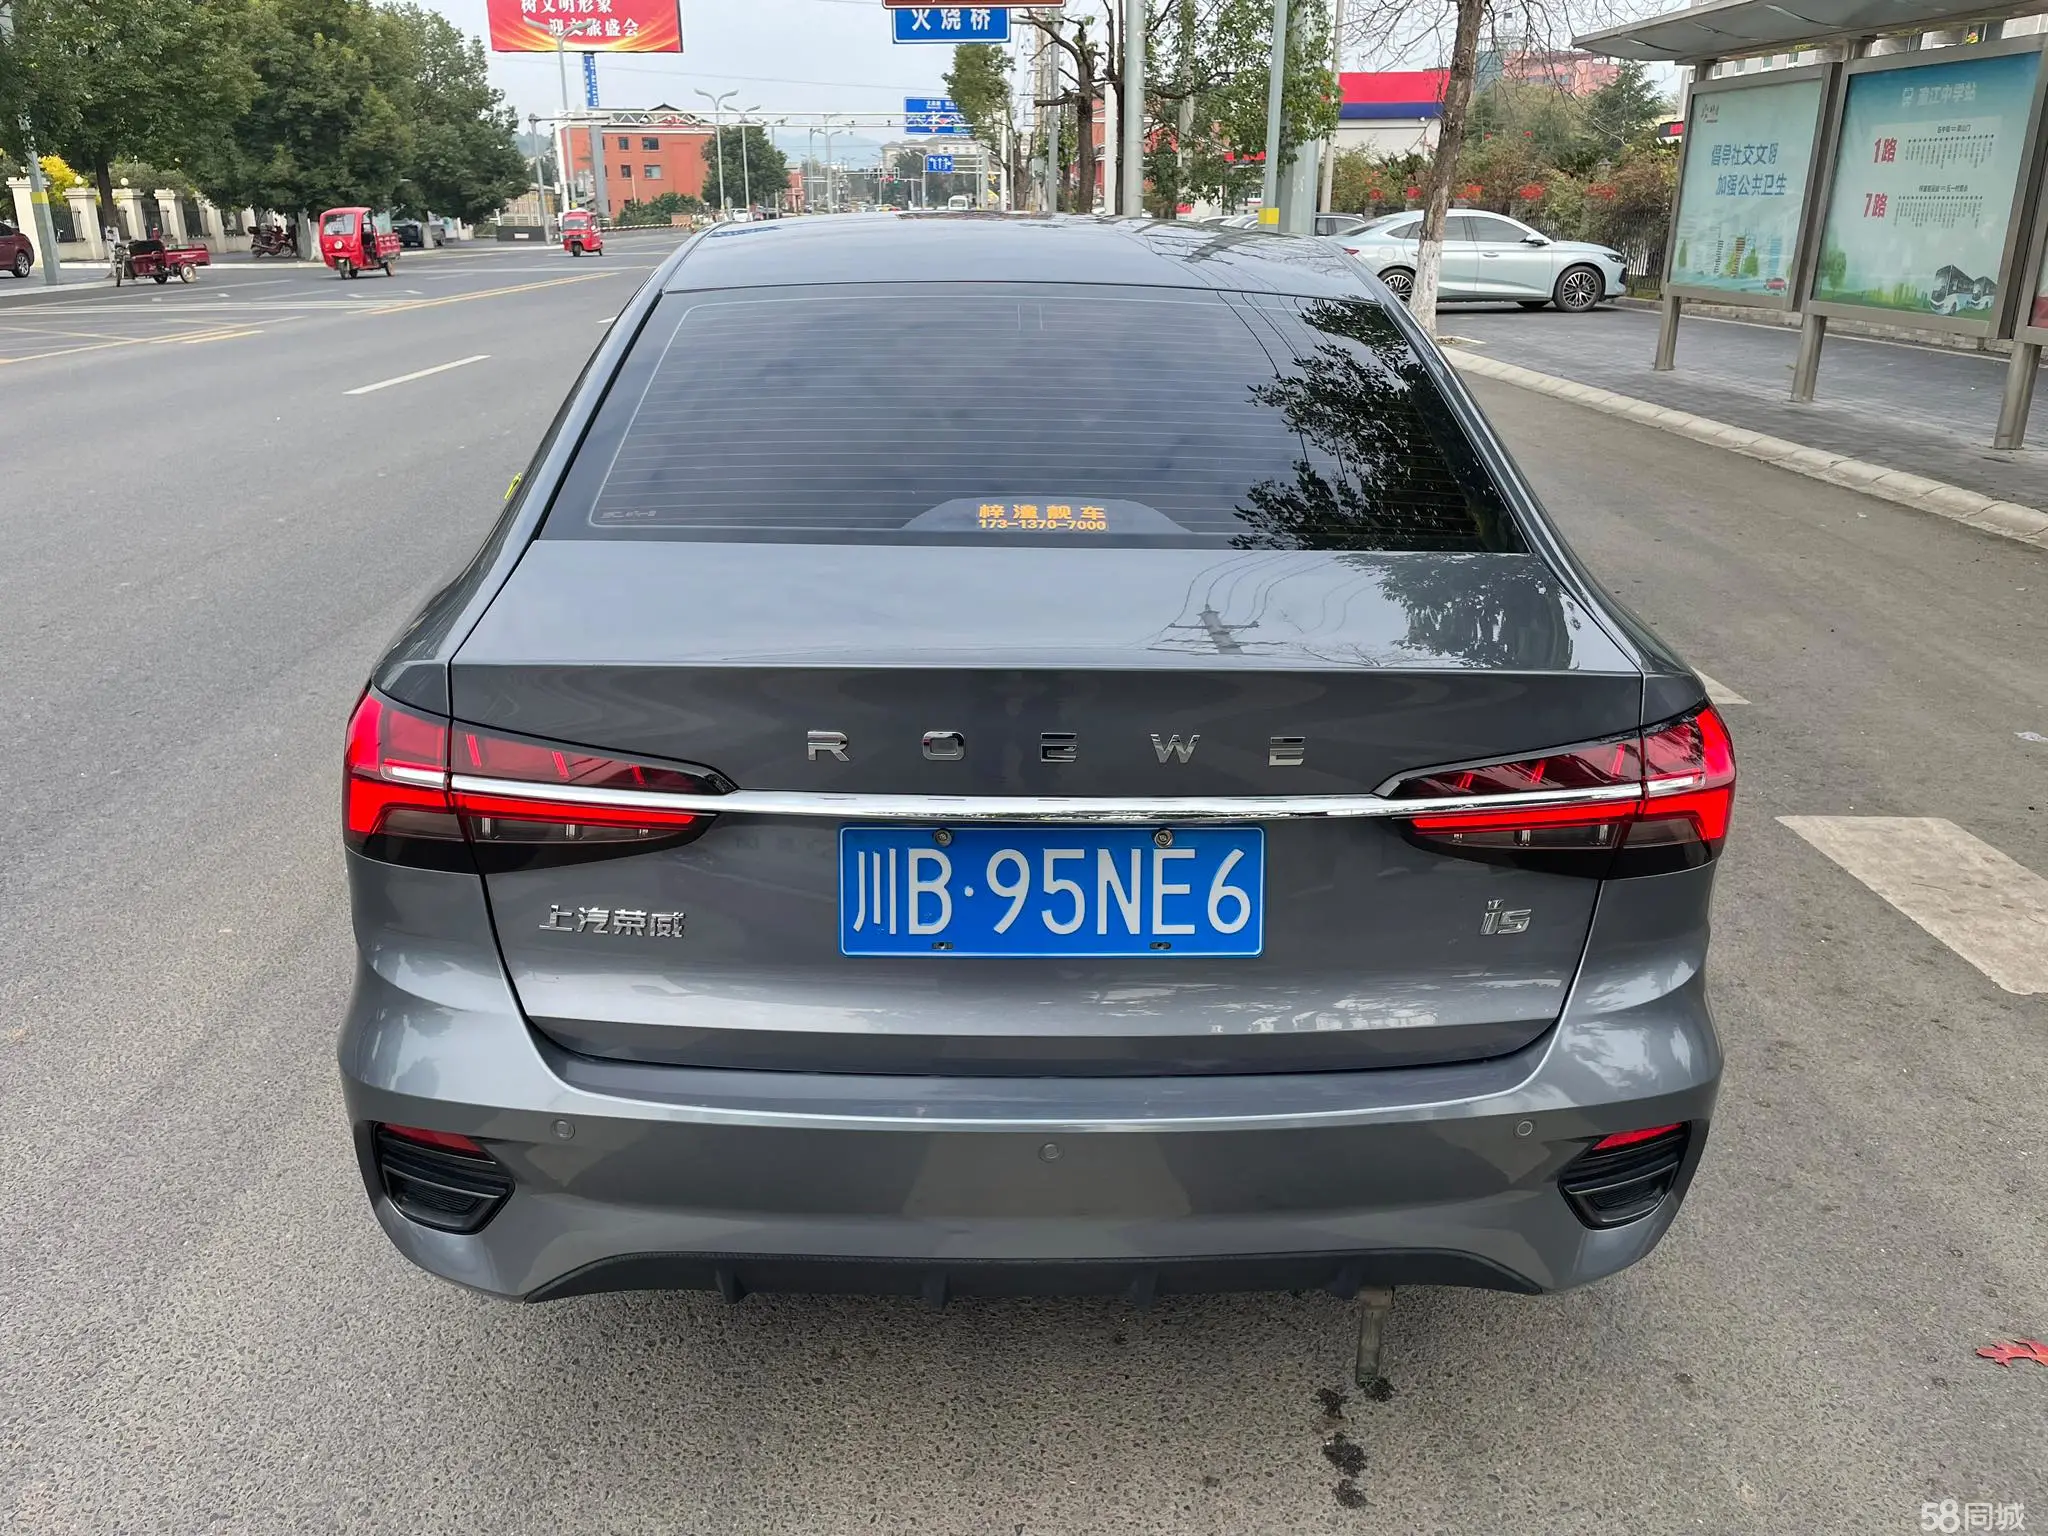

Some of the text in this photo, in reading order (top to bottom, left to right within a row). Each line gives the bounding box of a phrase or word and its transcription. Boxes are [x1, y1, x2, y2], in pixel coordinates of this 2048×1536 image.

[911, 8, 991, 31] 火烧桥
[1873, 137, 1898, 164] 1路
[1716, 172, 1788, 197] 加强公共卫生
[1864, 192, 1889, 219] 7路
[978, 503, 1106, 520] 梓潼靓车
[978, 519, 1107, 530] 173-1370-7000
[807, 731, 1306, 766] ROEWE
[538, 904, 685, 938] 上汽荣威
[1480, 899, 1532, 935] i5
